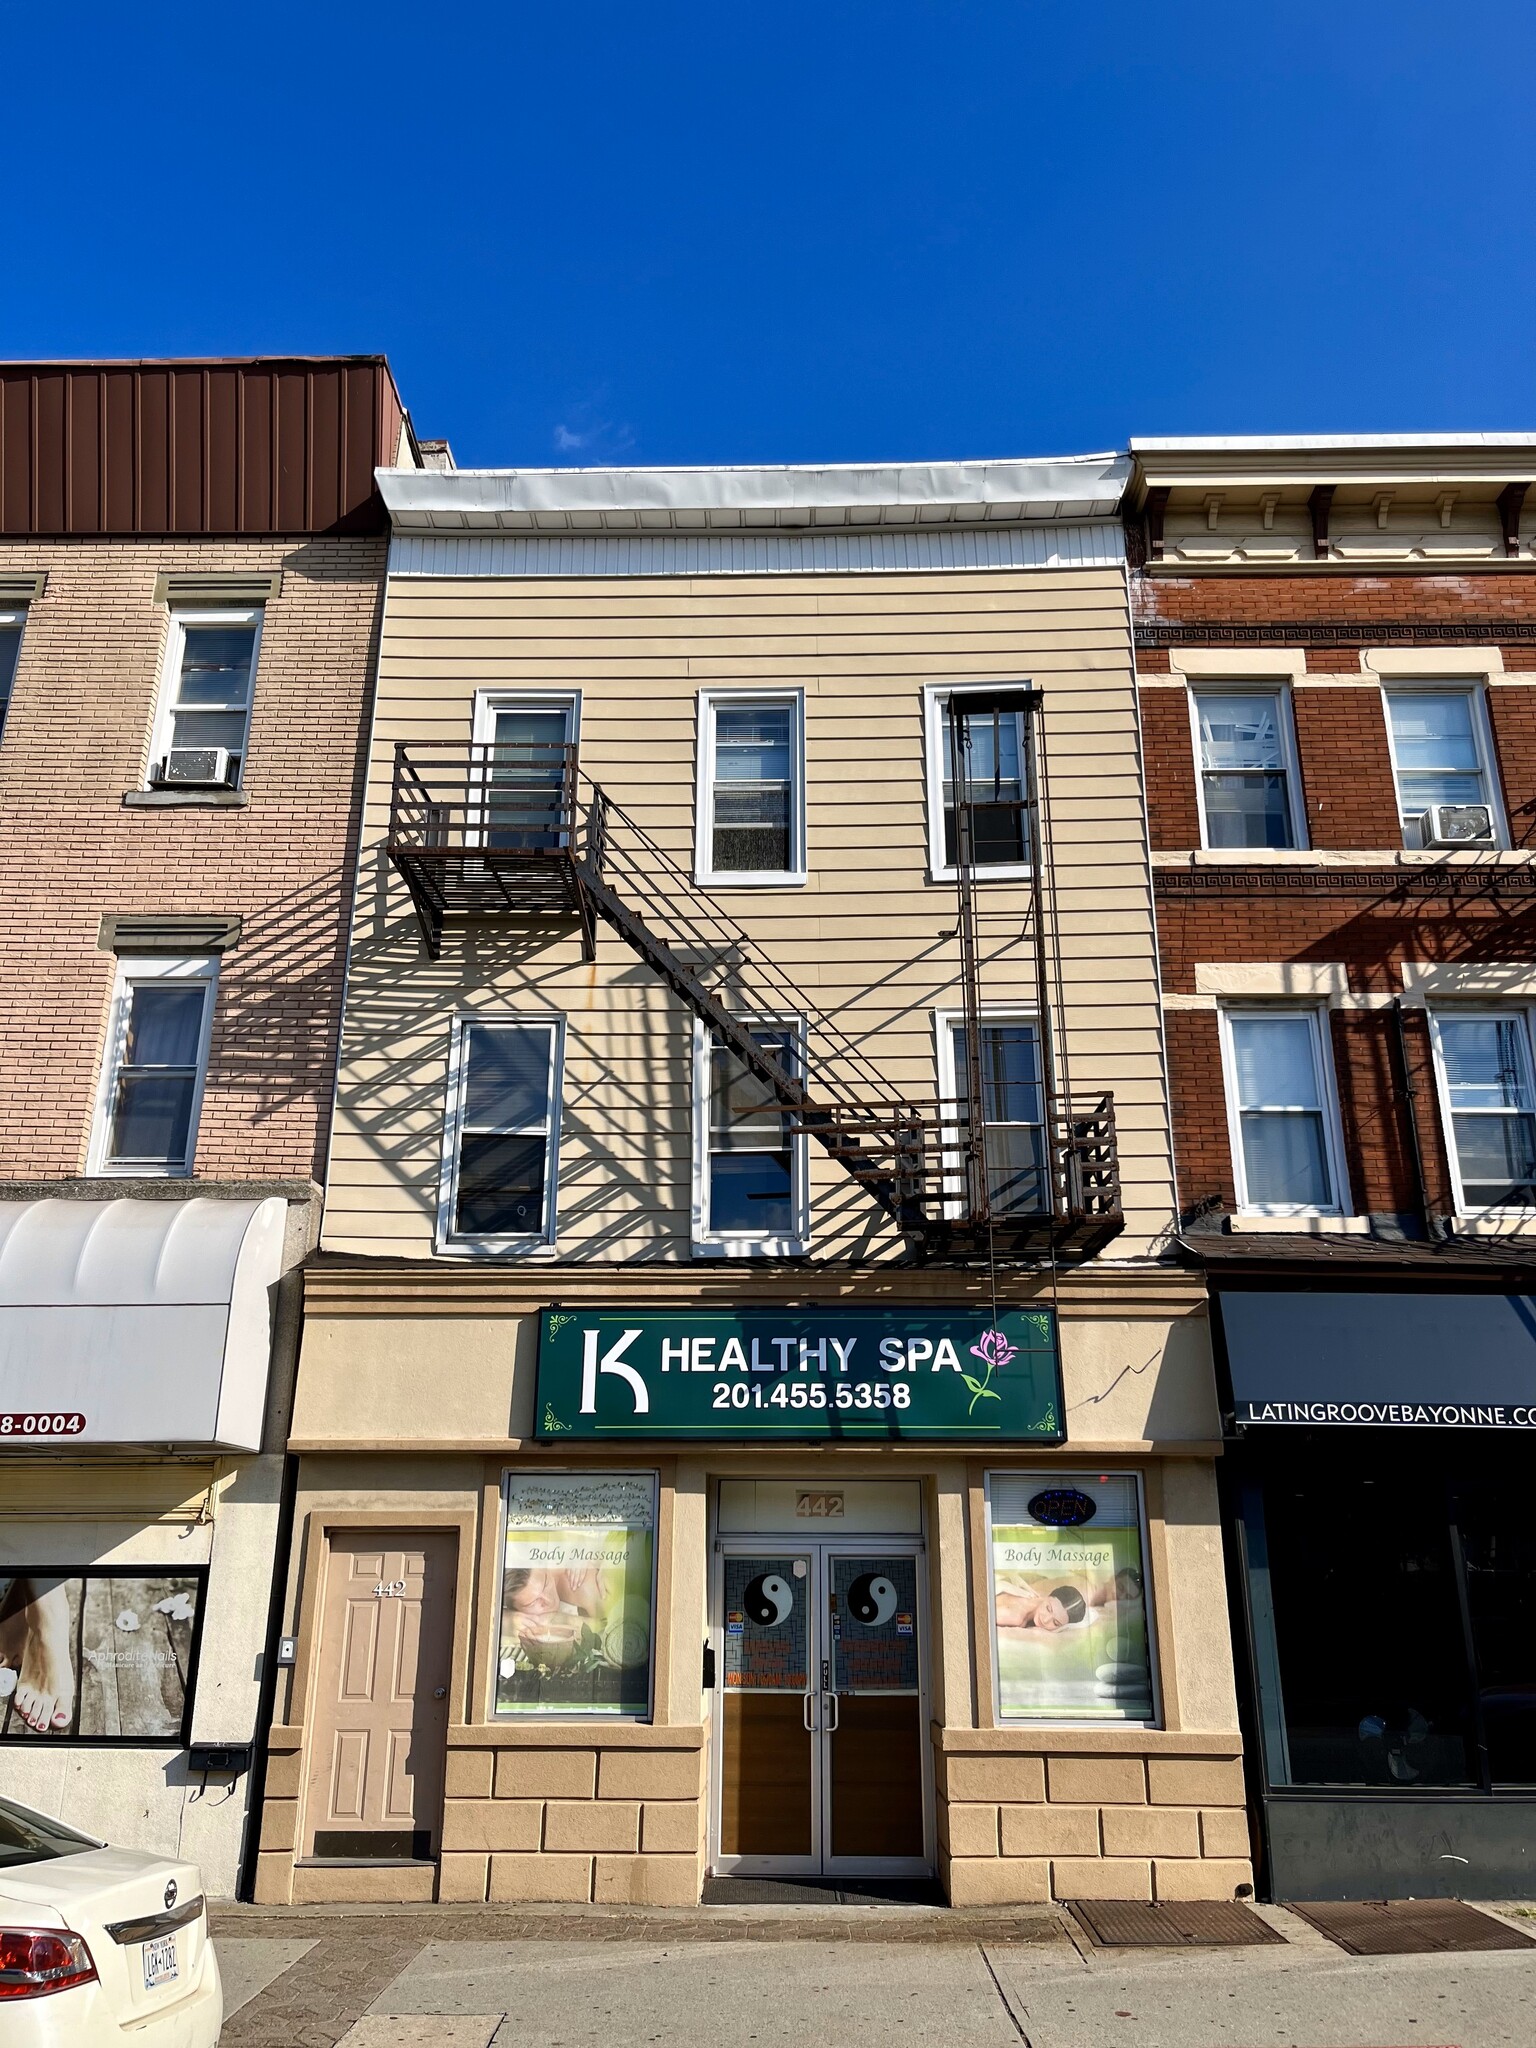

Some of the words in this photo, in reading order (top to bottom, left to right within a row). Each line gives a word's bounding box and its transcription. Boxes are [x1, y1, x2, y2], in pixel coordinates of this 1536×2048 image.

[579, 1330, 649, 1413] K
[661, 1337, 858, 1372] HEALTHY
[879, 1337, 963, 1373] SPA
[712, 1383, 911, 1409] 201.455.5358
[0, 1415, 80, 1433] 8-0004
[797, 1496, 844, 1517] 442
[1034, 1499, 1088, 1516] OPEN
[529, 1547, 565, 1565] Body
[569, 1548, 630, 1565] Massage
[1004, 1547, 1042, 1566] Body
[1046, 1548, 1110, 1566] Massage
[371, 1580, 407, 1598] 442
